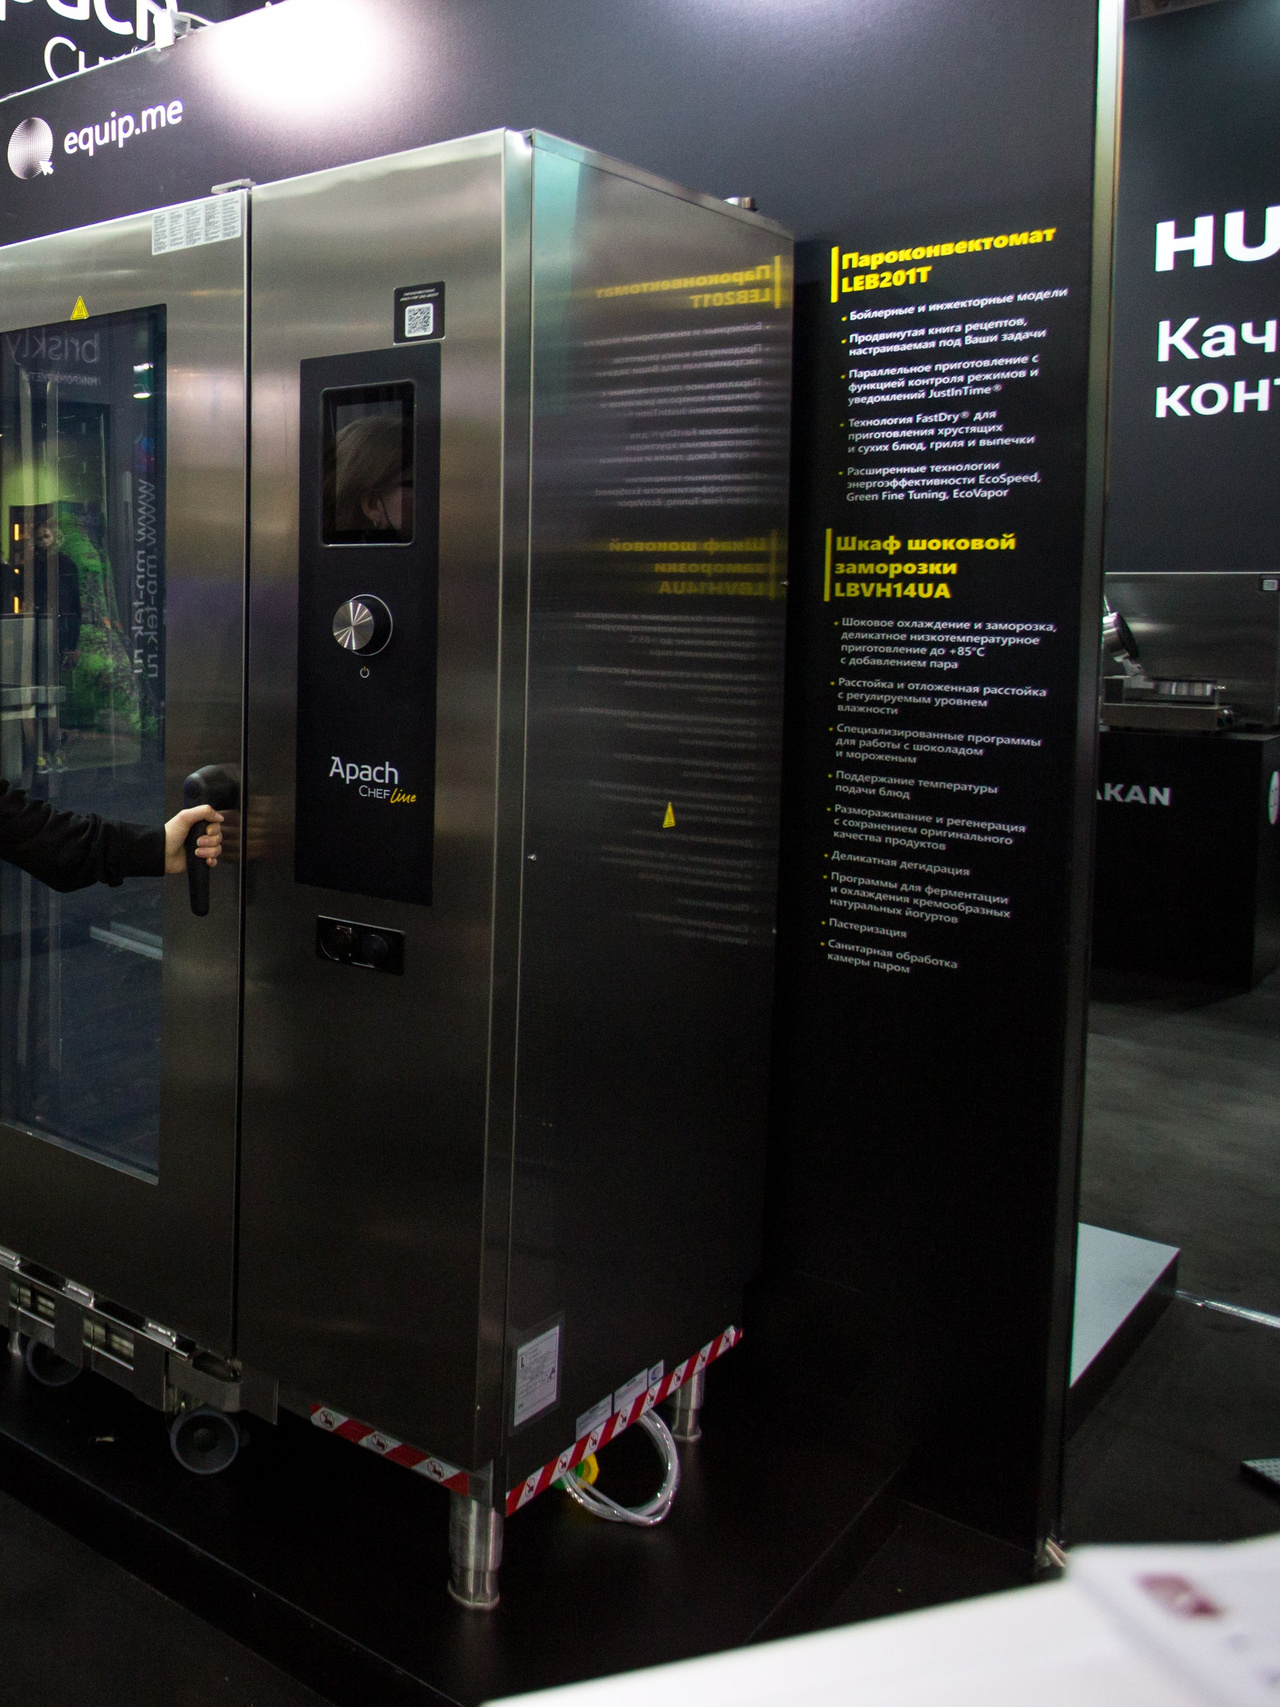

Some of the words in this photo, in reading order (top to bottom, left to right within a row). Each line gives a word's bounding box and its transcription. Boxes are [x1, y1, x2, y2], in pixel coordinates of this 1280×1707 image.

[63, 99, 184, 157] equip.me
[841, 227, 1058, 271] Пароконвектомат
[841, 265, 933, 293] LEB201T
[849, 306, 915, 320] Бойлерные
[917, 304, 926, 312] и
[928, 294, 1014, 311] инжекторные
[1016, 288, 1068, 301] модели
[848, 340, 936, 355] настраиваемая
[938, 338, 962, 347] под
[964, 334, 998, 344] Ваши
[1000, 329, 1046, 341] задачи
[849, 328, 925, 344] Продвинутая
[928, 324, 962, 334] книга
[1157, 315, 1279, 363] Кач
[848, 364, 932, 379] Параллельное
[934, 356, 1029, 372] приготовление
[1031, 354, 1038, 362] с
[848, 378, 905, 393] функцией
[908, 375, 964, 386] контроля
[967, 369, 1027, 383] режимов
[1029, 368, 1039, 376] и
[848, 389, 926, 405] уведомлений
[848, 416, 913, 427] Технология
[972, 410, 997, 421] для
[848, 428, 934, 441] приготовления
[937, 424, 1003, 436] хрустящих
[857, 444, 889, 454] сухих
[929, 440, 964, 450] гриля
[967, 439, 976, 447] и
[979, 436, 1035, 446] выпечки
[847, 465, 927, 476] Расширенные
[929, 462, 1000, 472] технологии
[847, 477, 975, 489] энергоэффективности
[846, 488, 878, 501] Green
[881, 488, 905, 500] Fine
[952, 488, 1009, 499] EcoVapor
[836, 535, 901, 554] Шкаф
[907, 533, 1016, 550] шоковой
[834, 562, 957, 578] заморозки
[834, 583, 951, 598] LBVH14UA
[841, 617, 894, 627] Шоковое
[896, 620, 971, 629] охлаждение
[840, 632, 907, 640] деликатное
[909, 634, 1040, 645] низкотемпературное
[840, 644, 927, 656] приготовление
[929, 647, 945, 656] до
[848, 656, 926, 667] добавлением
[929, 660, 958, 670] пара
[838, 677, 894, 688] Расстойка
[907, 683, 980, 692] отложенная
[982, 686, 1047, 696] расстойка
[837, 691, 843, 699] с
[846, 692, 931, 703] регулируемым
[934, 697, 988, 706] уровнем
[837, 704, 898, 714] влажности
[836, 723, 964, 740] Специализированные
[967, 734, 1041, 746] программы
[835, 738, 856, 746] для
[858, 738, 901, 749] работы
[903, 742, 909, 750] с
[912, 744, 983, 755] шоколадом
[845, 751, 916, 763] мороженым
[329, 755, 400, 785] Apach
[835, 770, 915, 785] Поддержание
[917, 779, 998, 794] температуры
[835, 784, 876, 794] подачи
[878, 786, 910, 800] блюд
[1095, 782, 1171, 807] KAN
[834, 804, 932, 822] Размораживание
[946, 818, 1026, 832] регенерация
[833, 831, 882, 842] качества
[884, 836, 946, 850] продуктов
[842, 819, 917, 833] сохранением
[920, 828, 1013, 844] оригинального
[830, 850, 897, 866] Деликатная
[899, 861, 970, 875] дегидрация
[831, 871, 898, 888] Программы
[899, 883, 921, 892] для
[924, 885, 1008, 904] ферментации
[829, 899, 902, 914] натуральных
[905, 907, 958, 923] йогуртов
[840, 887, 909, 902] охлаждения
[912, 898, 1010, 917] кремообразных
[829, 917, 907, 937] Пастеризация
[827, 939, 893, 957] Санитарная
[895, 951, 958, 968] обработка
[827, 953, 870, 966] камеры
[873, 961, 910, 973] паром
